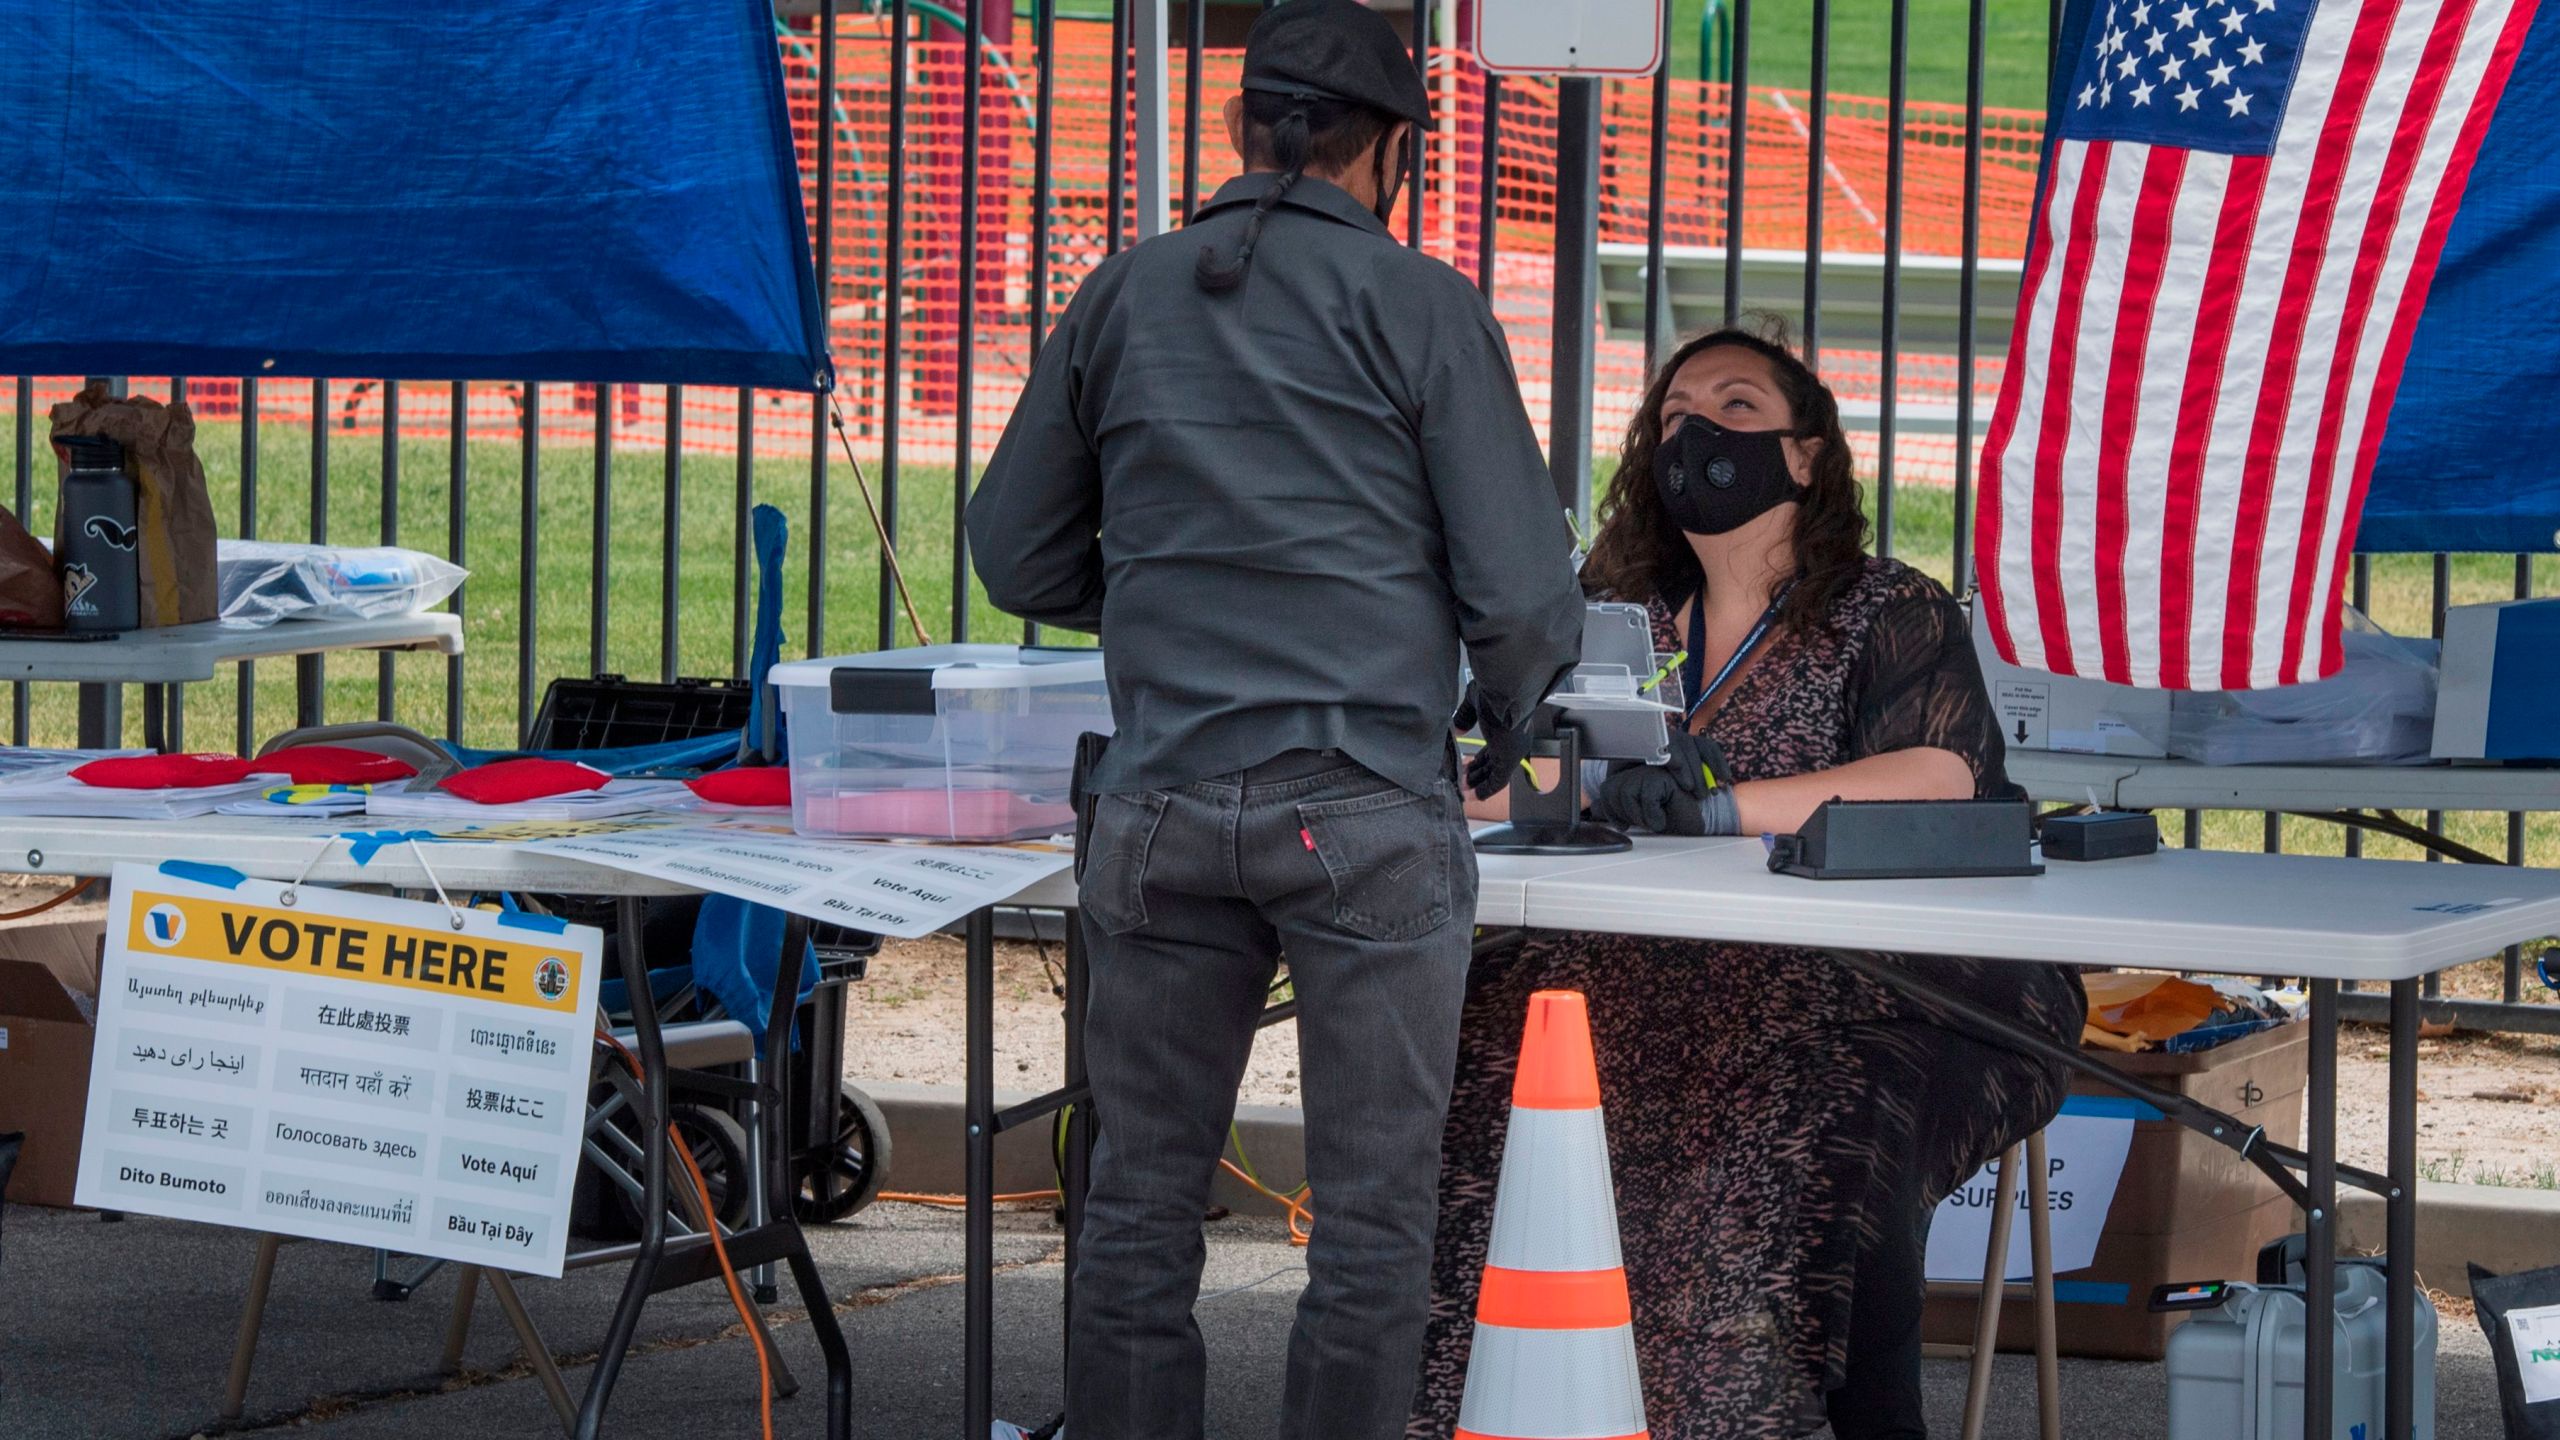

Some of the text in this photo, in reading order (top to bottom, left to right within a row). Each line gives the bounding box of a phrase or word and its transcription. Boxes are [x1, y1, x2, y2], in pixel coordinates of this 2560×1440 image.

[873, 877, 952, 904] Vote Aquí
[221, 911, 368, 973] VOTE
[382, 934, 508, 994] HERE
[318, 1004, 411, 1036] 在此處投票
[300, 1066, 412, 1101] मतदान यहाँ करें
[466, 1087, 544, 1119] 投票はここ
[131, 1107, 229, 1139] 투표하는 곳
[275, 1122, 417, 1159] Голосовать здесь
[119, 1166, 227, 1195] Dito Bumoto
[461, 1153, 538, 1183] Vote Aquí
[1949, 1185, 2075, 1211] SUPLES
[448, 1214, 534, 1248] Bầu Tại Đây
